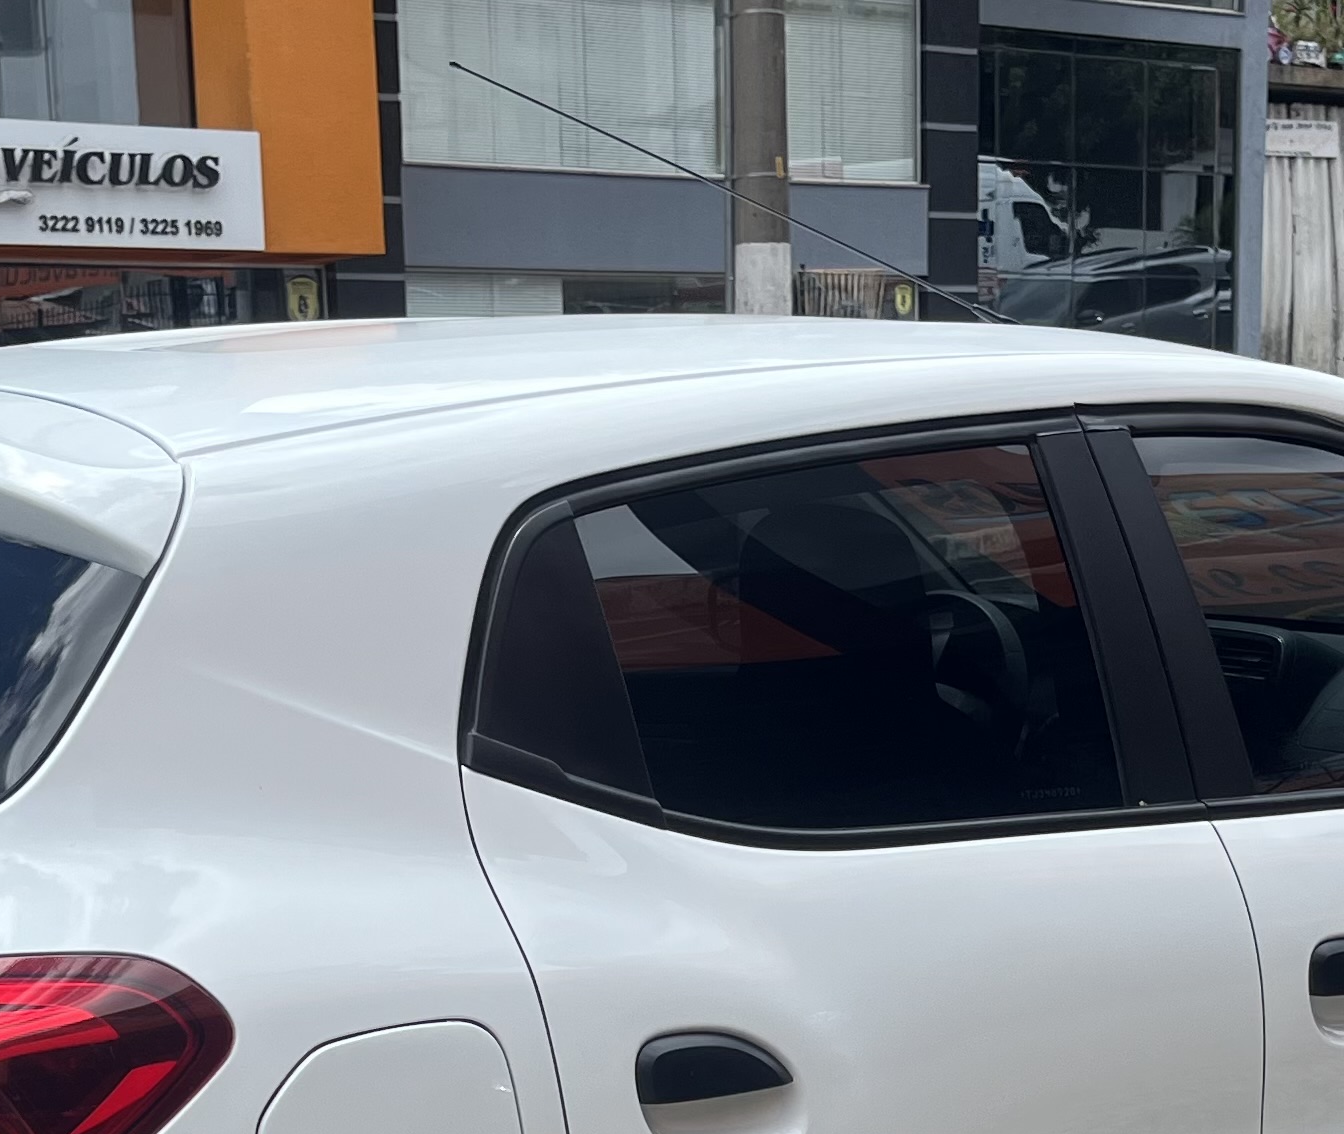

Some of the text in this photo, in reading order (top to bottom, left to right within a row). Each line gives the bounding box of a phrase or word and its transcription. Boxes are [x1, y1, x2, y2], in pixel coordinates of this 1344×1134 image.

[1, 137, 220, 189] VEÍCULOS
[38, 214, 80, 233] 3222
[86, 216, 125, 234] 9119
[140, 218, 180, 236] 3225
[185, 219, 223, 237] 1969
